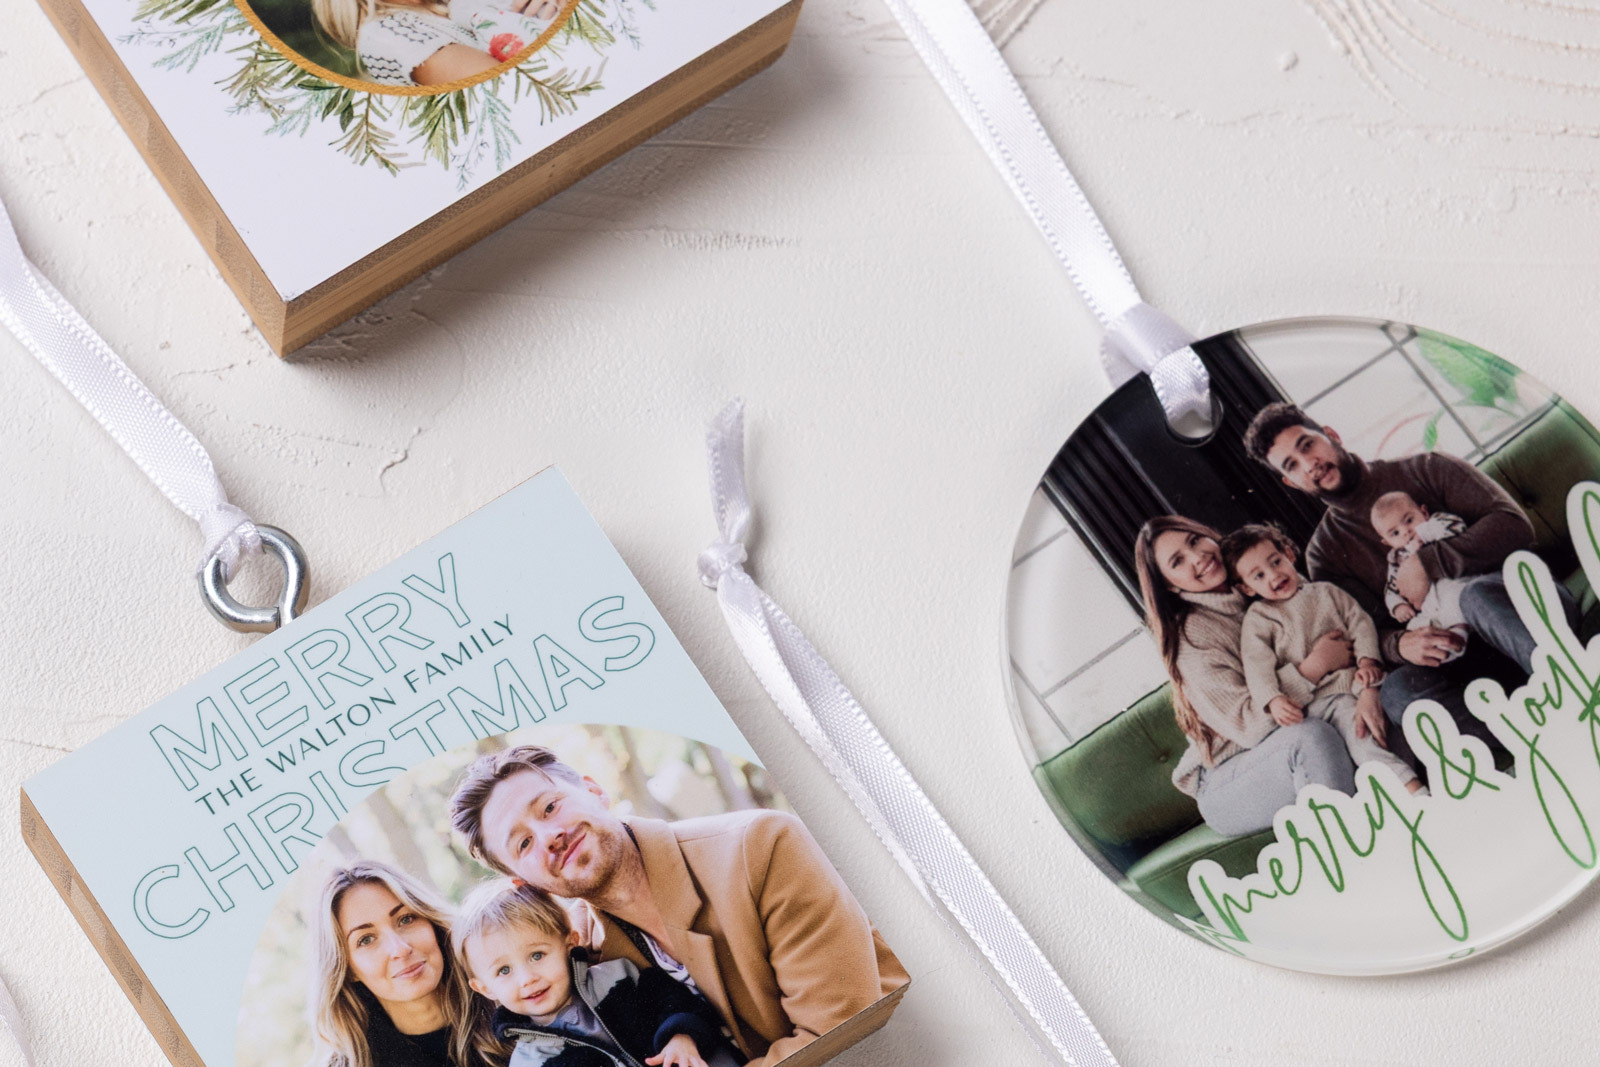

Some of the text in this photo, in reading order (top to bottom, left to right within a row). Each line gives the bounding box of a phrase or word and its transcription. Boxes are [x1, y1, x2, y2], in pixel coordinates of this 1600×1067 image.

[133, 595, 656, 940] CHRISTMAS
[150, 552, 472, 792] MERRY
[194, 613, 514, 815] THE WALTON FAMILY
[1199, 774, 1469, 942] merry
[1416, 712, 1501, 800] &
